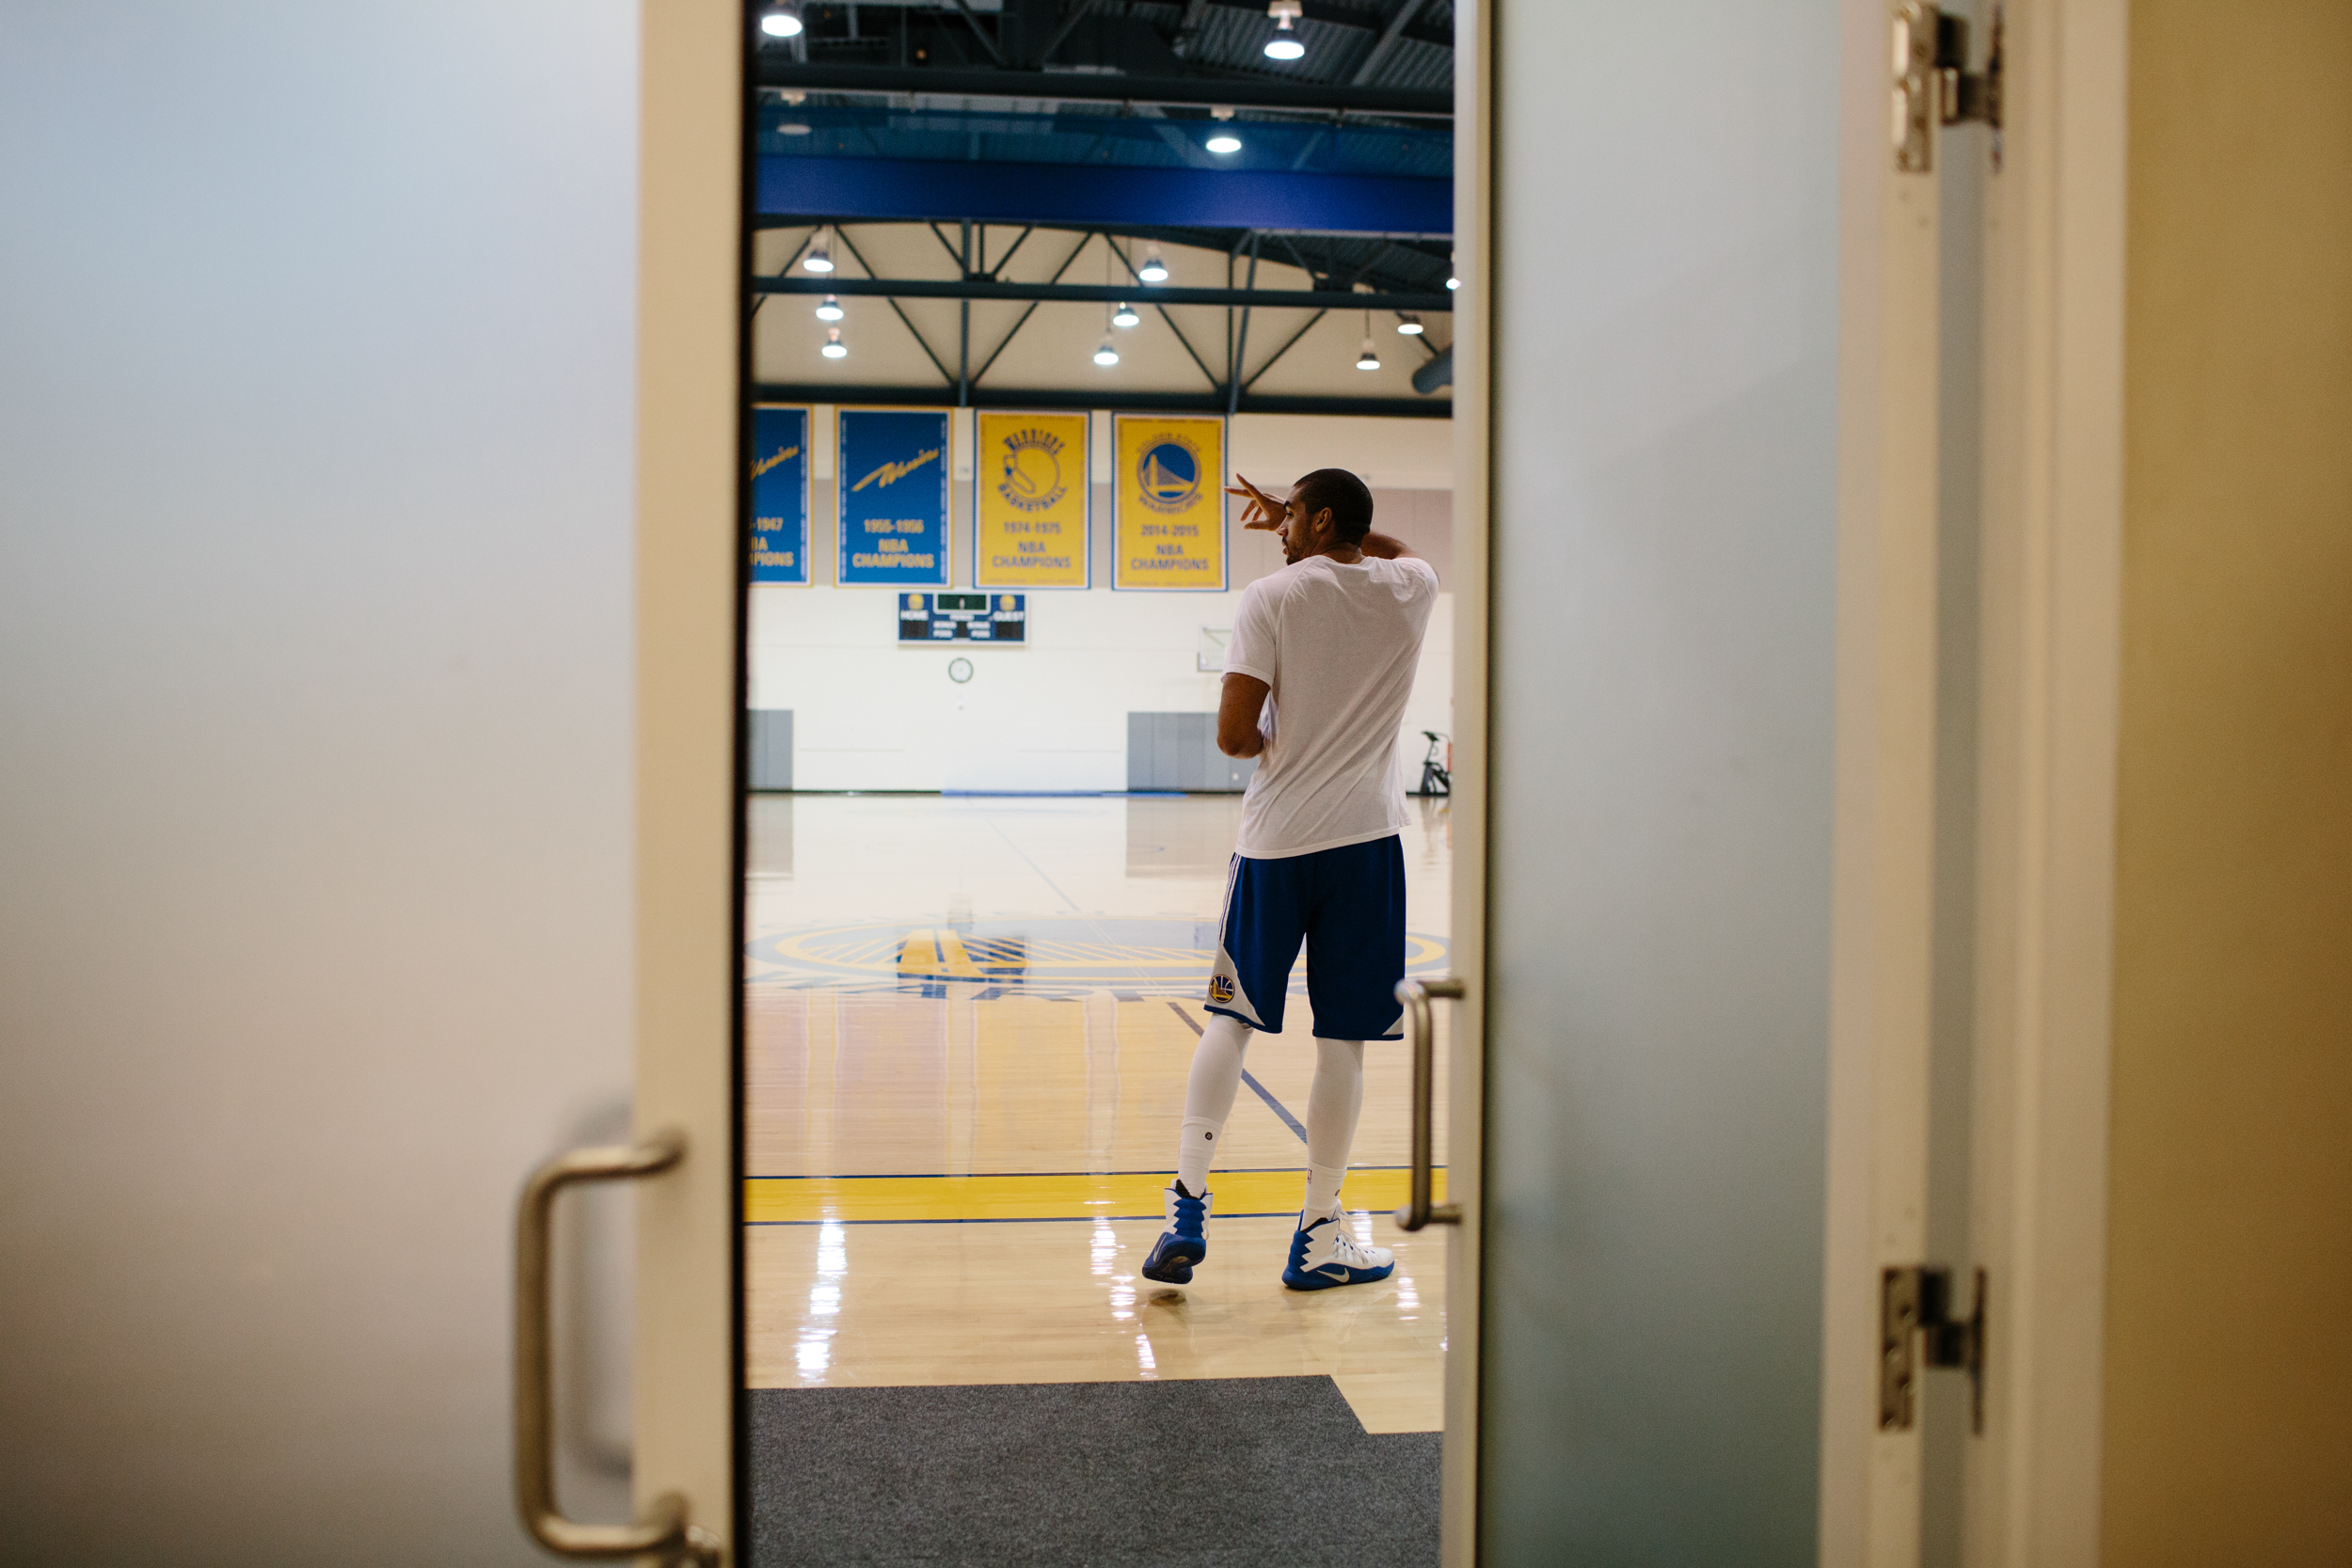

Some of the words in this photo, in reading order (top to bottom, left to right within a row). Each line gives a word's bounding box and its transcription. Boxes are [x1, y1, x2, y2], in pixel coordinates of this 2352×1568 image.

[1004, 521, 1062, 534] 1974-1975
[1141, 524, 1200, 537] 2014-2015
[750, 536, 769, 551] BA
[878, 538, 909, 553] NBA
[1018, 541, 1046, 554] NBA
[1155, 544, 1184, 556] NBA
[852, 552, 934, 568] CHAMPIONS
[992, 555, 1072, 569] CHAMPIONS
[1131, 557, 1210, 571] CHAMPIONS
